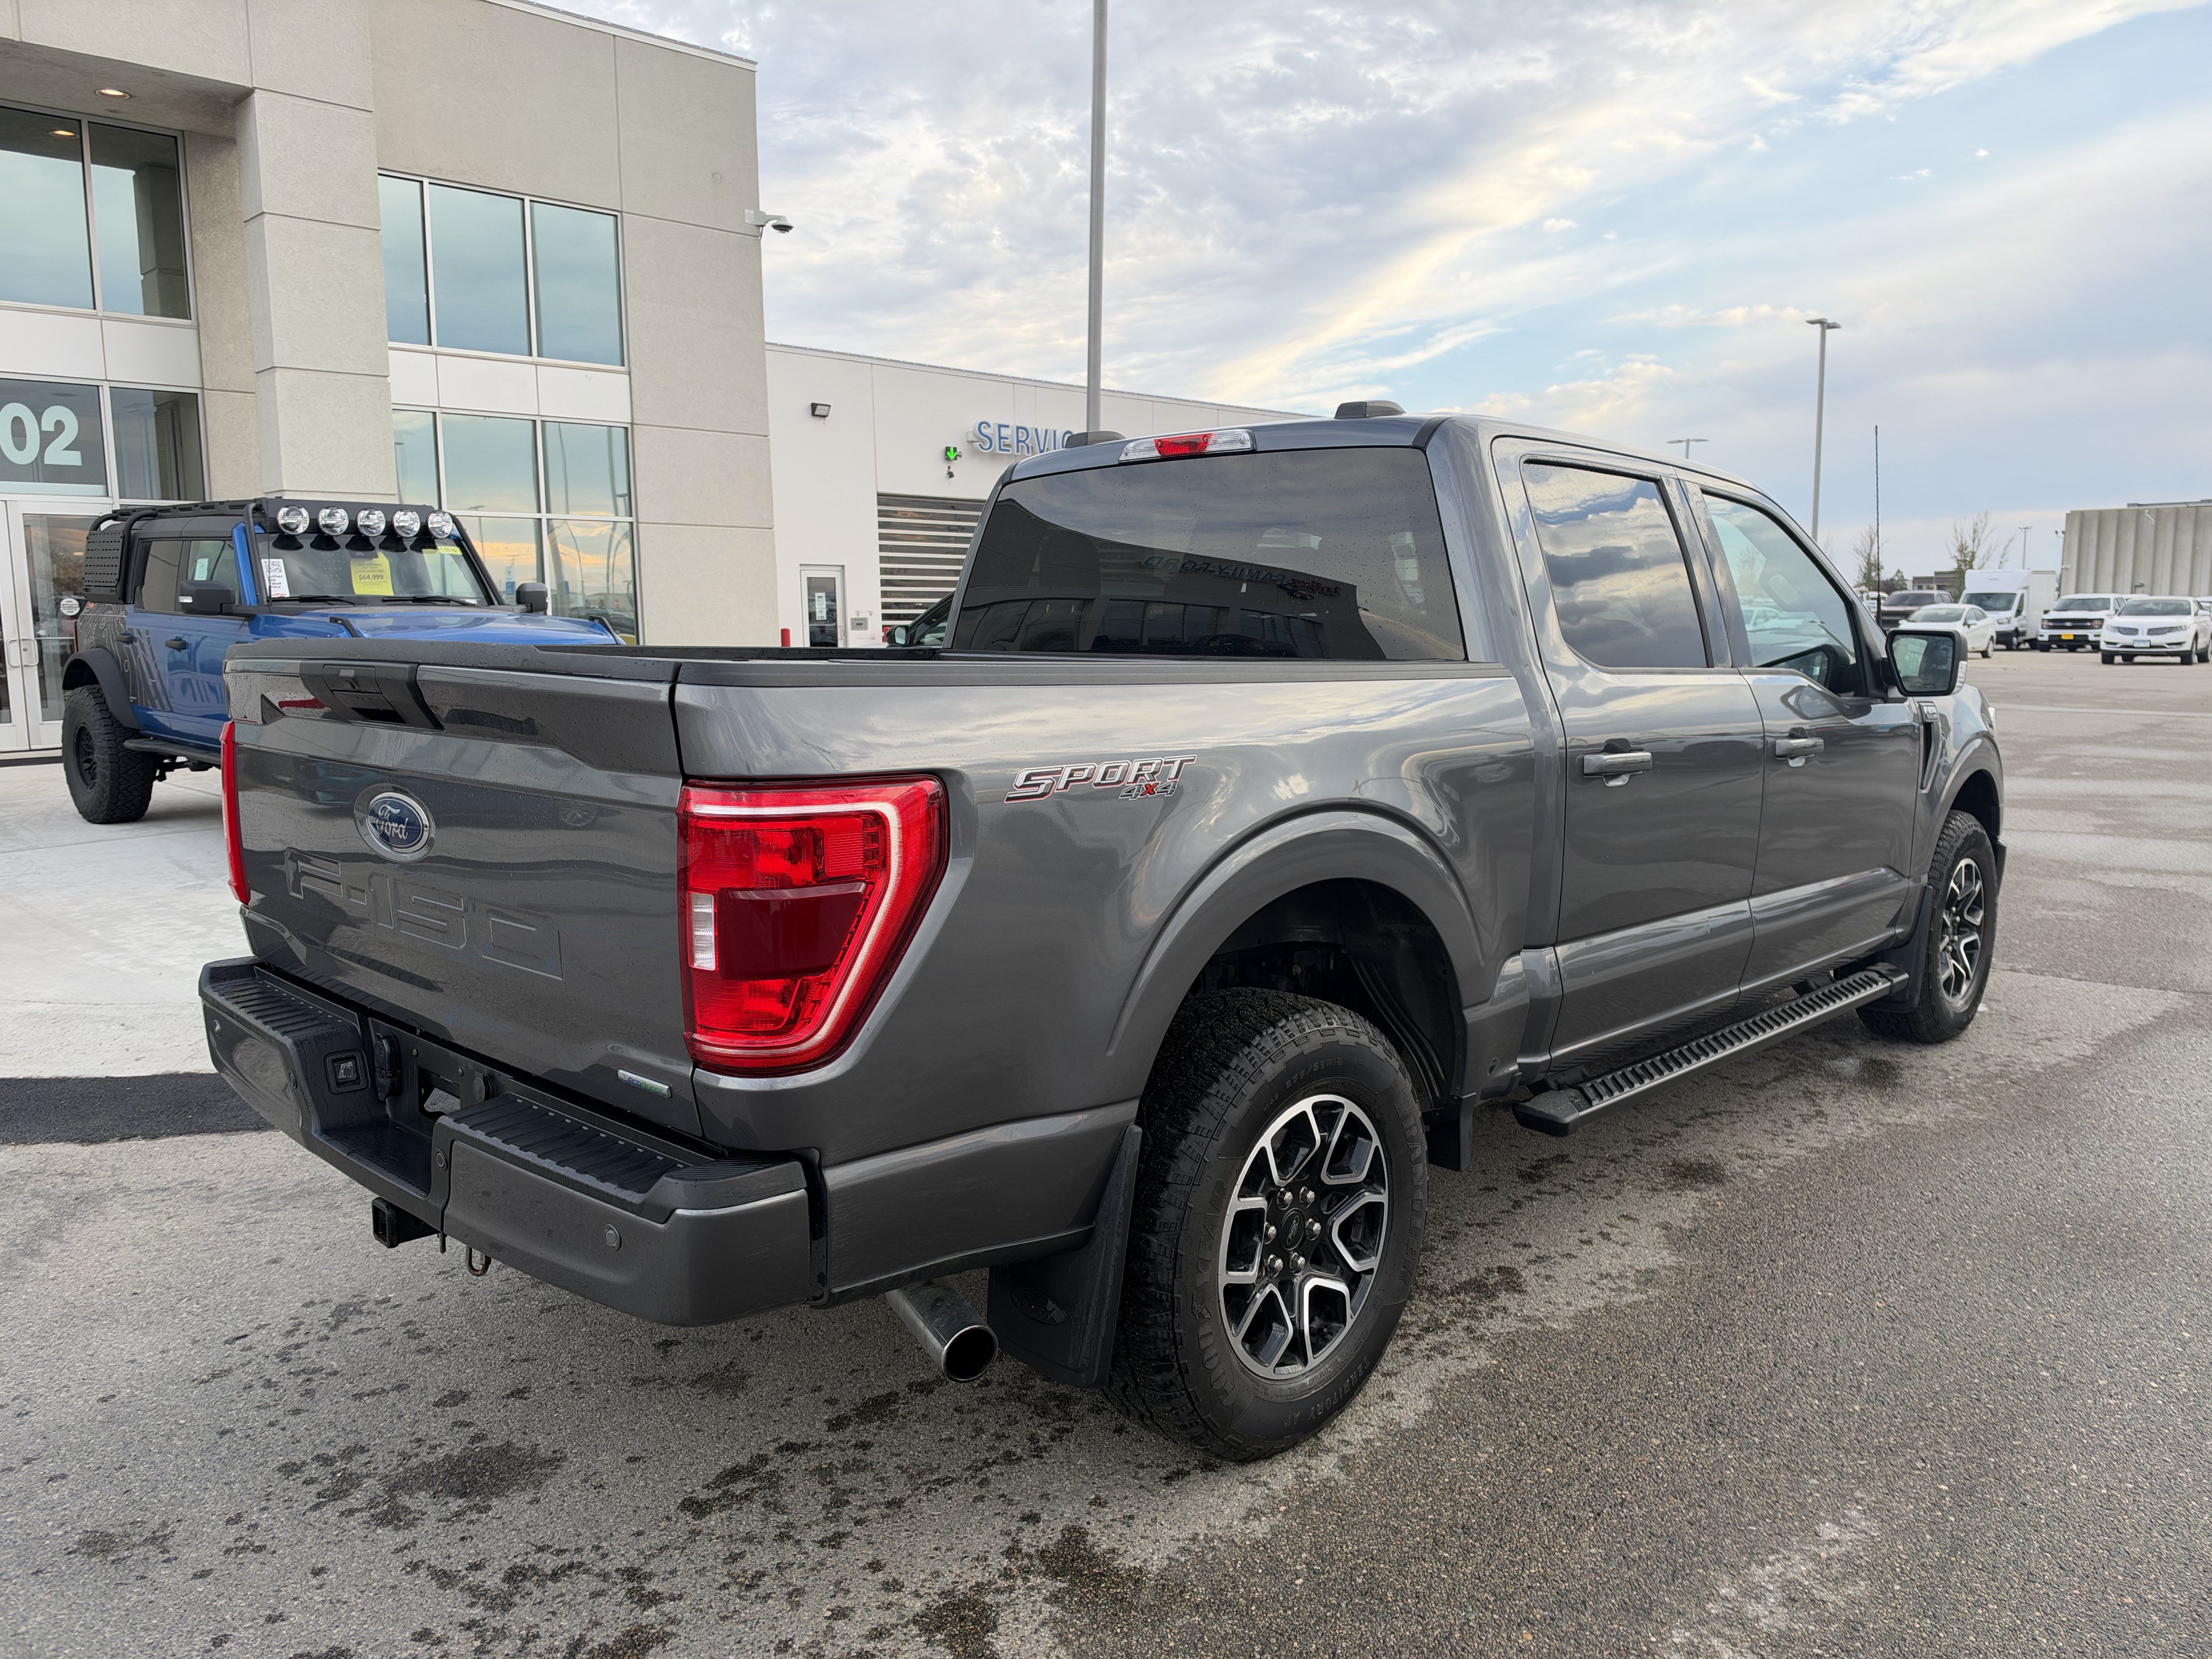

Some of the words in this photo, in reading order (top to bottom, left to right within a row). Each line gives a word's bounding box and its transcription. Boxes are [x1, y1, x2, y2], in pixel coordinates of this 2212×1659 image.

[0, 402, 82, 466] 02
[1004, 754, 1198, 804] SPORT
[375, 804, 409, 840] Ford
[284, 847, 563, 981] F-150
[1392, 1094, 1426, 1287] WRANGLER
[1287, 1219, 1299, 1241] Ford
[1308, 1355, 1371, 1420] TERRITORY
